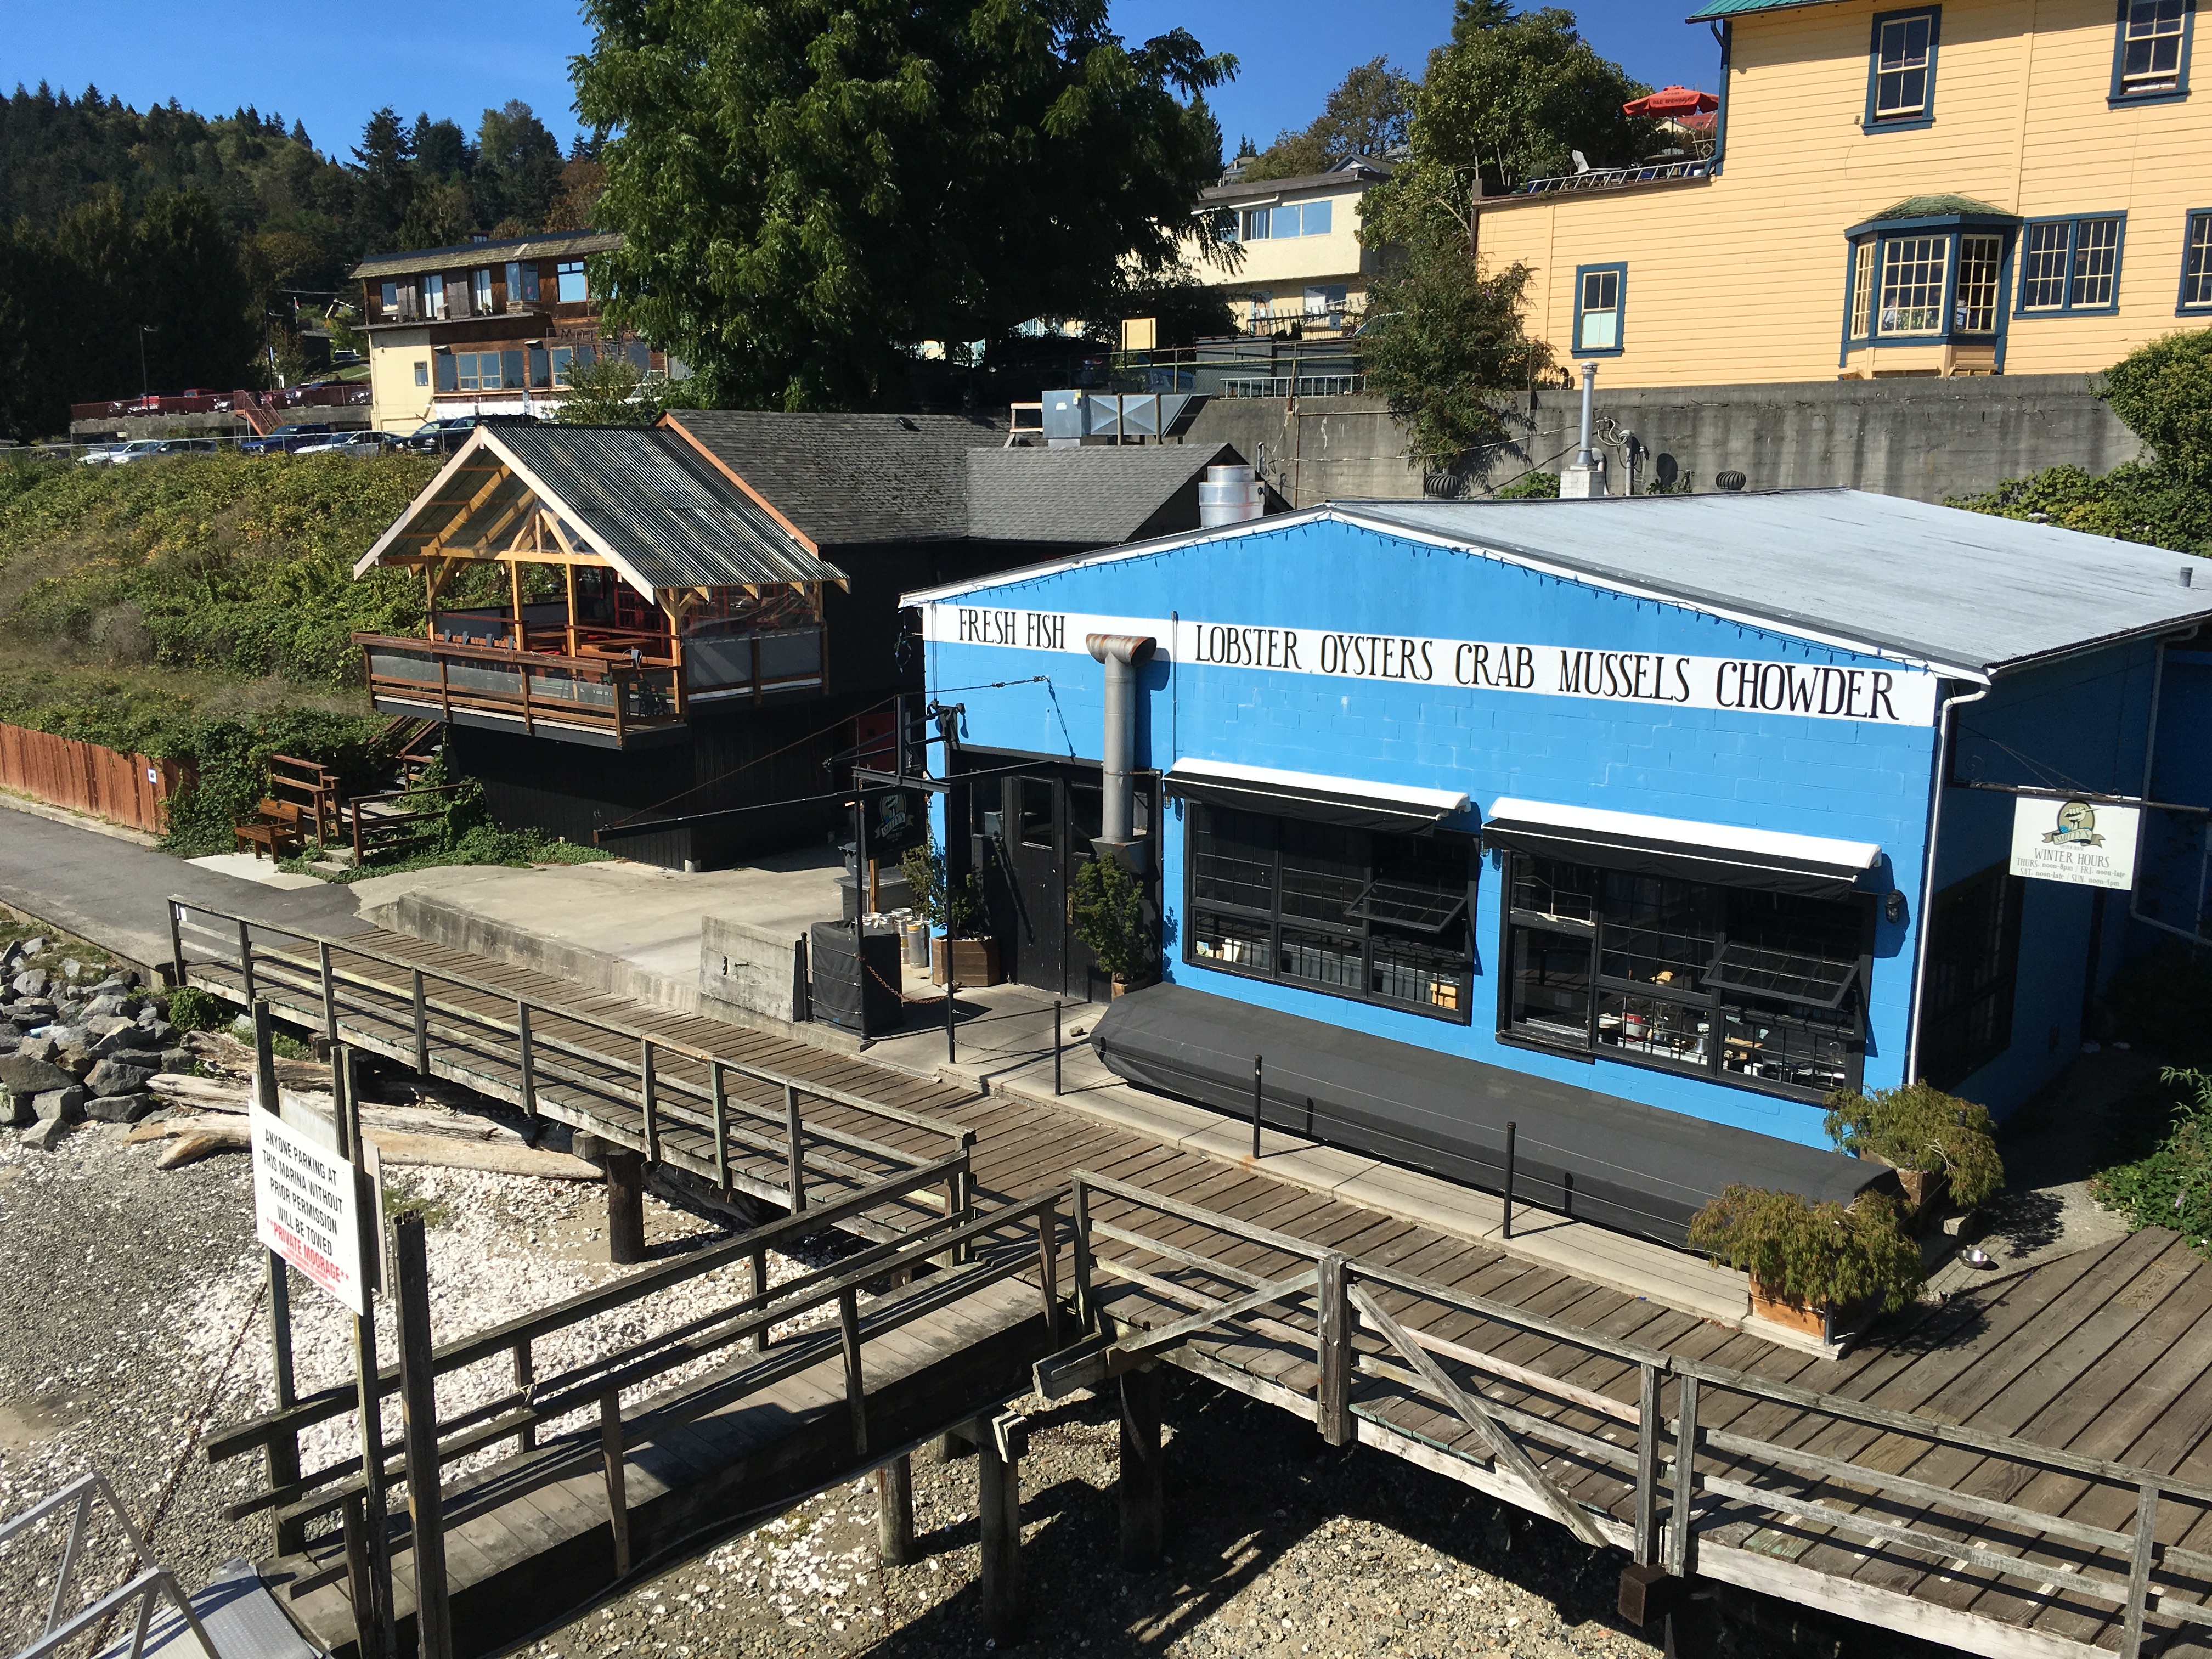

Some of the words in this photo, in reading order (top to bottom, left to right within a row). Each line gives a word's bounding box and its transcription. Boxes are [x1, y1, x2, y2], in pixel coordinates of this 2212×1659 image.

[560, 328, 640, 343] MOLY'S
[958, 609, 1017, 646] FRESH
[1026, 613, 1066, 650] FISH
[1195, 624, 1303, 670] LOBSTER
[1320, 634, 1434, 681] OYSTERS
[1455, 644, 1535, 689] CRAB
[1558, 650, 1690, 703] MUSSELS
[1716, 662, 1900, 720] CHOWDER
[2056, 830, 2089, 843] SMITTY'S
[2017, 857, 2040, 868] THURS.
[2042, 862, 2073, 871] noon-8pm
[2080, 866, 2094, 874] FRI.
[2096, 870, 2126, 878] noon-late
[2020, 867, 2033, 876] SAT.
[2035, 871, 2064, 879] noon-late
[2071, 874, 2086, 883] SUN.
[2034, 848, 2073, 864] WINTER
[2077, 853, 2110, 868] HOURS
[266, 1128, 292, 1159] ANYONE
[294, 1146, 325, 1180] PARKING
[328, 1167, 336, 1186] AT
[262, 1148, 277, 1172] THIS
[279, 1160, 307, 1192] MARINA
[308, 1179, 342, 1215] WITHOUT
[270, 1177, 290, 1204] PRIOR
[292, 1192, 337, 1235] PERMISSION
[277, 1204, 294, 1230] WILL
[295, 1217, 304, 1238] BE
[306, 1225, 332, 1256] TOWED
